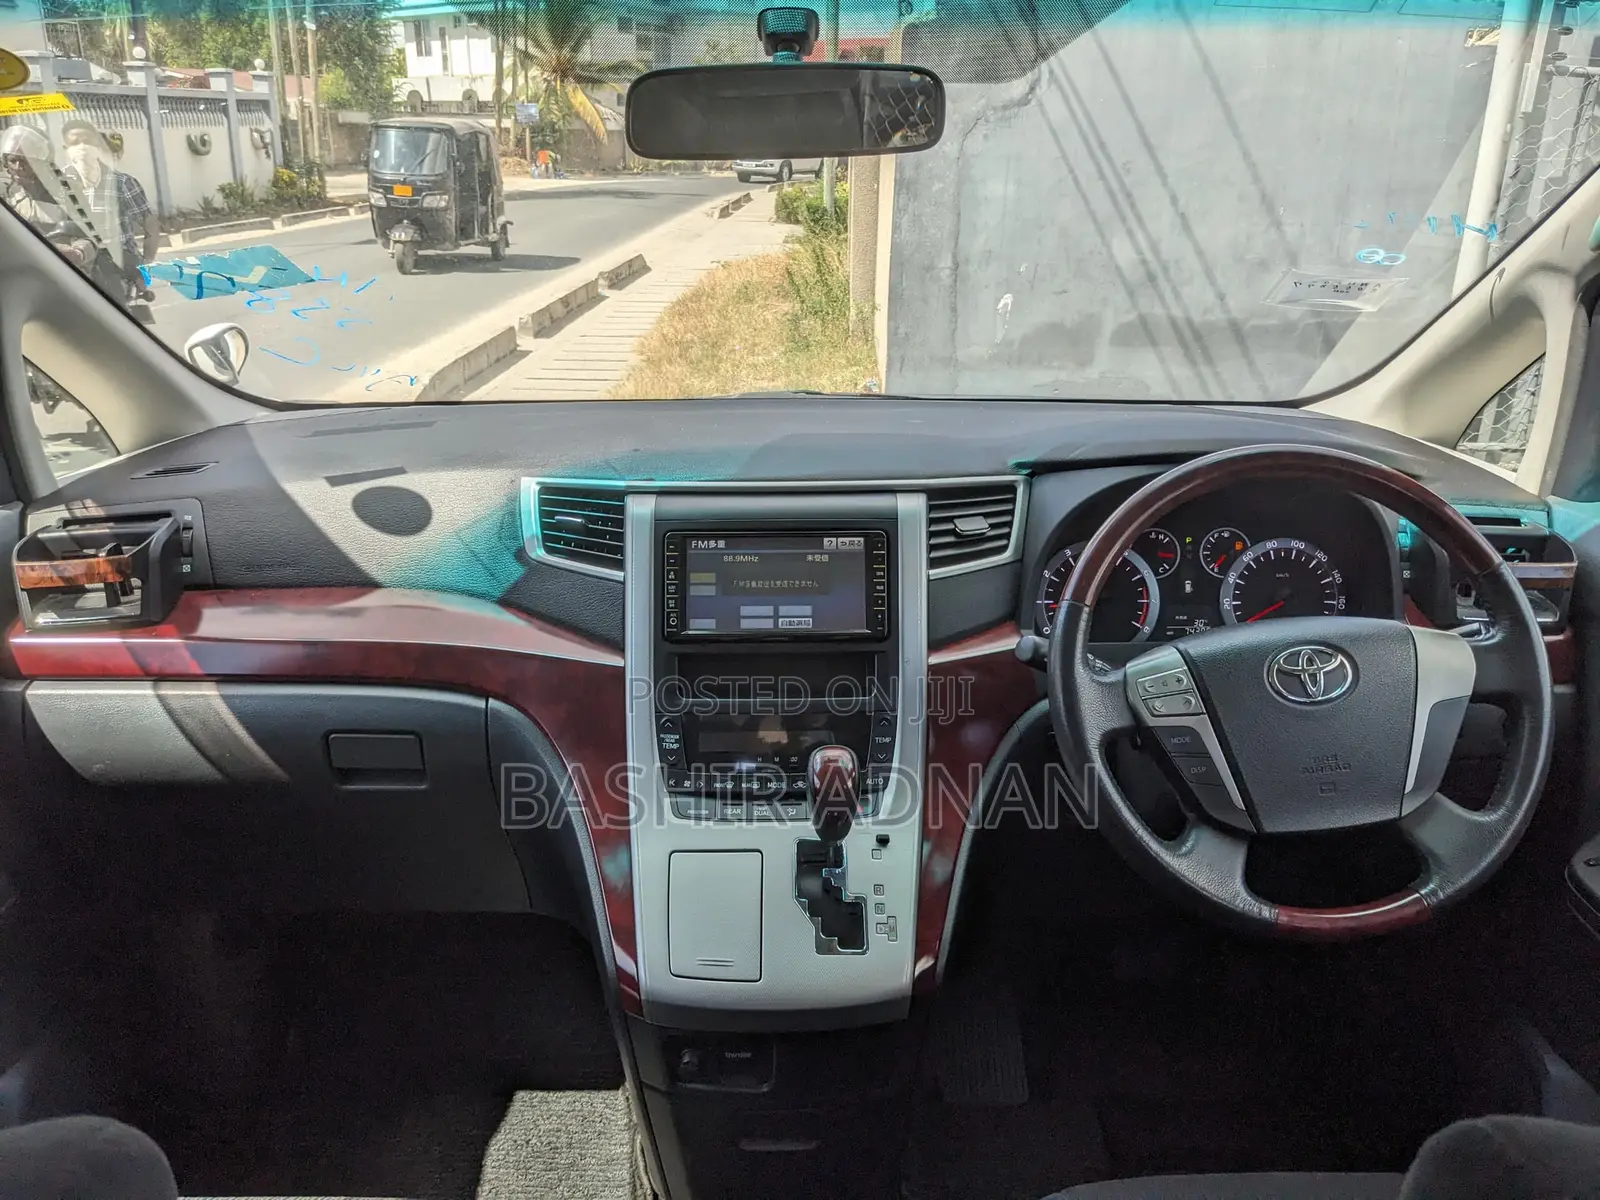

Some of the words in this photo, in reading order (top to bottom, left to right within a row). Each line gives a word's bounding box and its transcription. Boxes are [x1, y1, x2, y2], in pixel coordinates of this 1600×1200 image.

[1265, 540, 1278, 549] 80
[1290, 540, 1305, 549] 100
[1064, 549, 1072, 557] 3
[1242, 551, 1254, 562] 60
[1315, 549, 1328, 562] 120
[1043, 570, 1051, 578] 2
[1227, 572, 1237, 584] 40
[1332, 569, 1343, 584] 140
[1223, 598, 1232, 610] 20
[1338, 595, 1346, 610] 160
[1170, 736, 1191, 744] MODE
[767, 781, 787, 789] MODE
